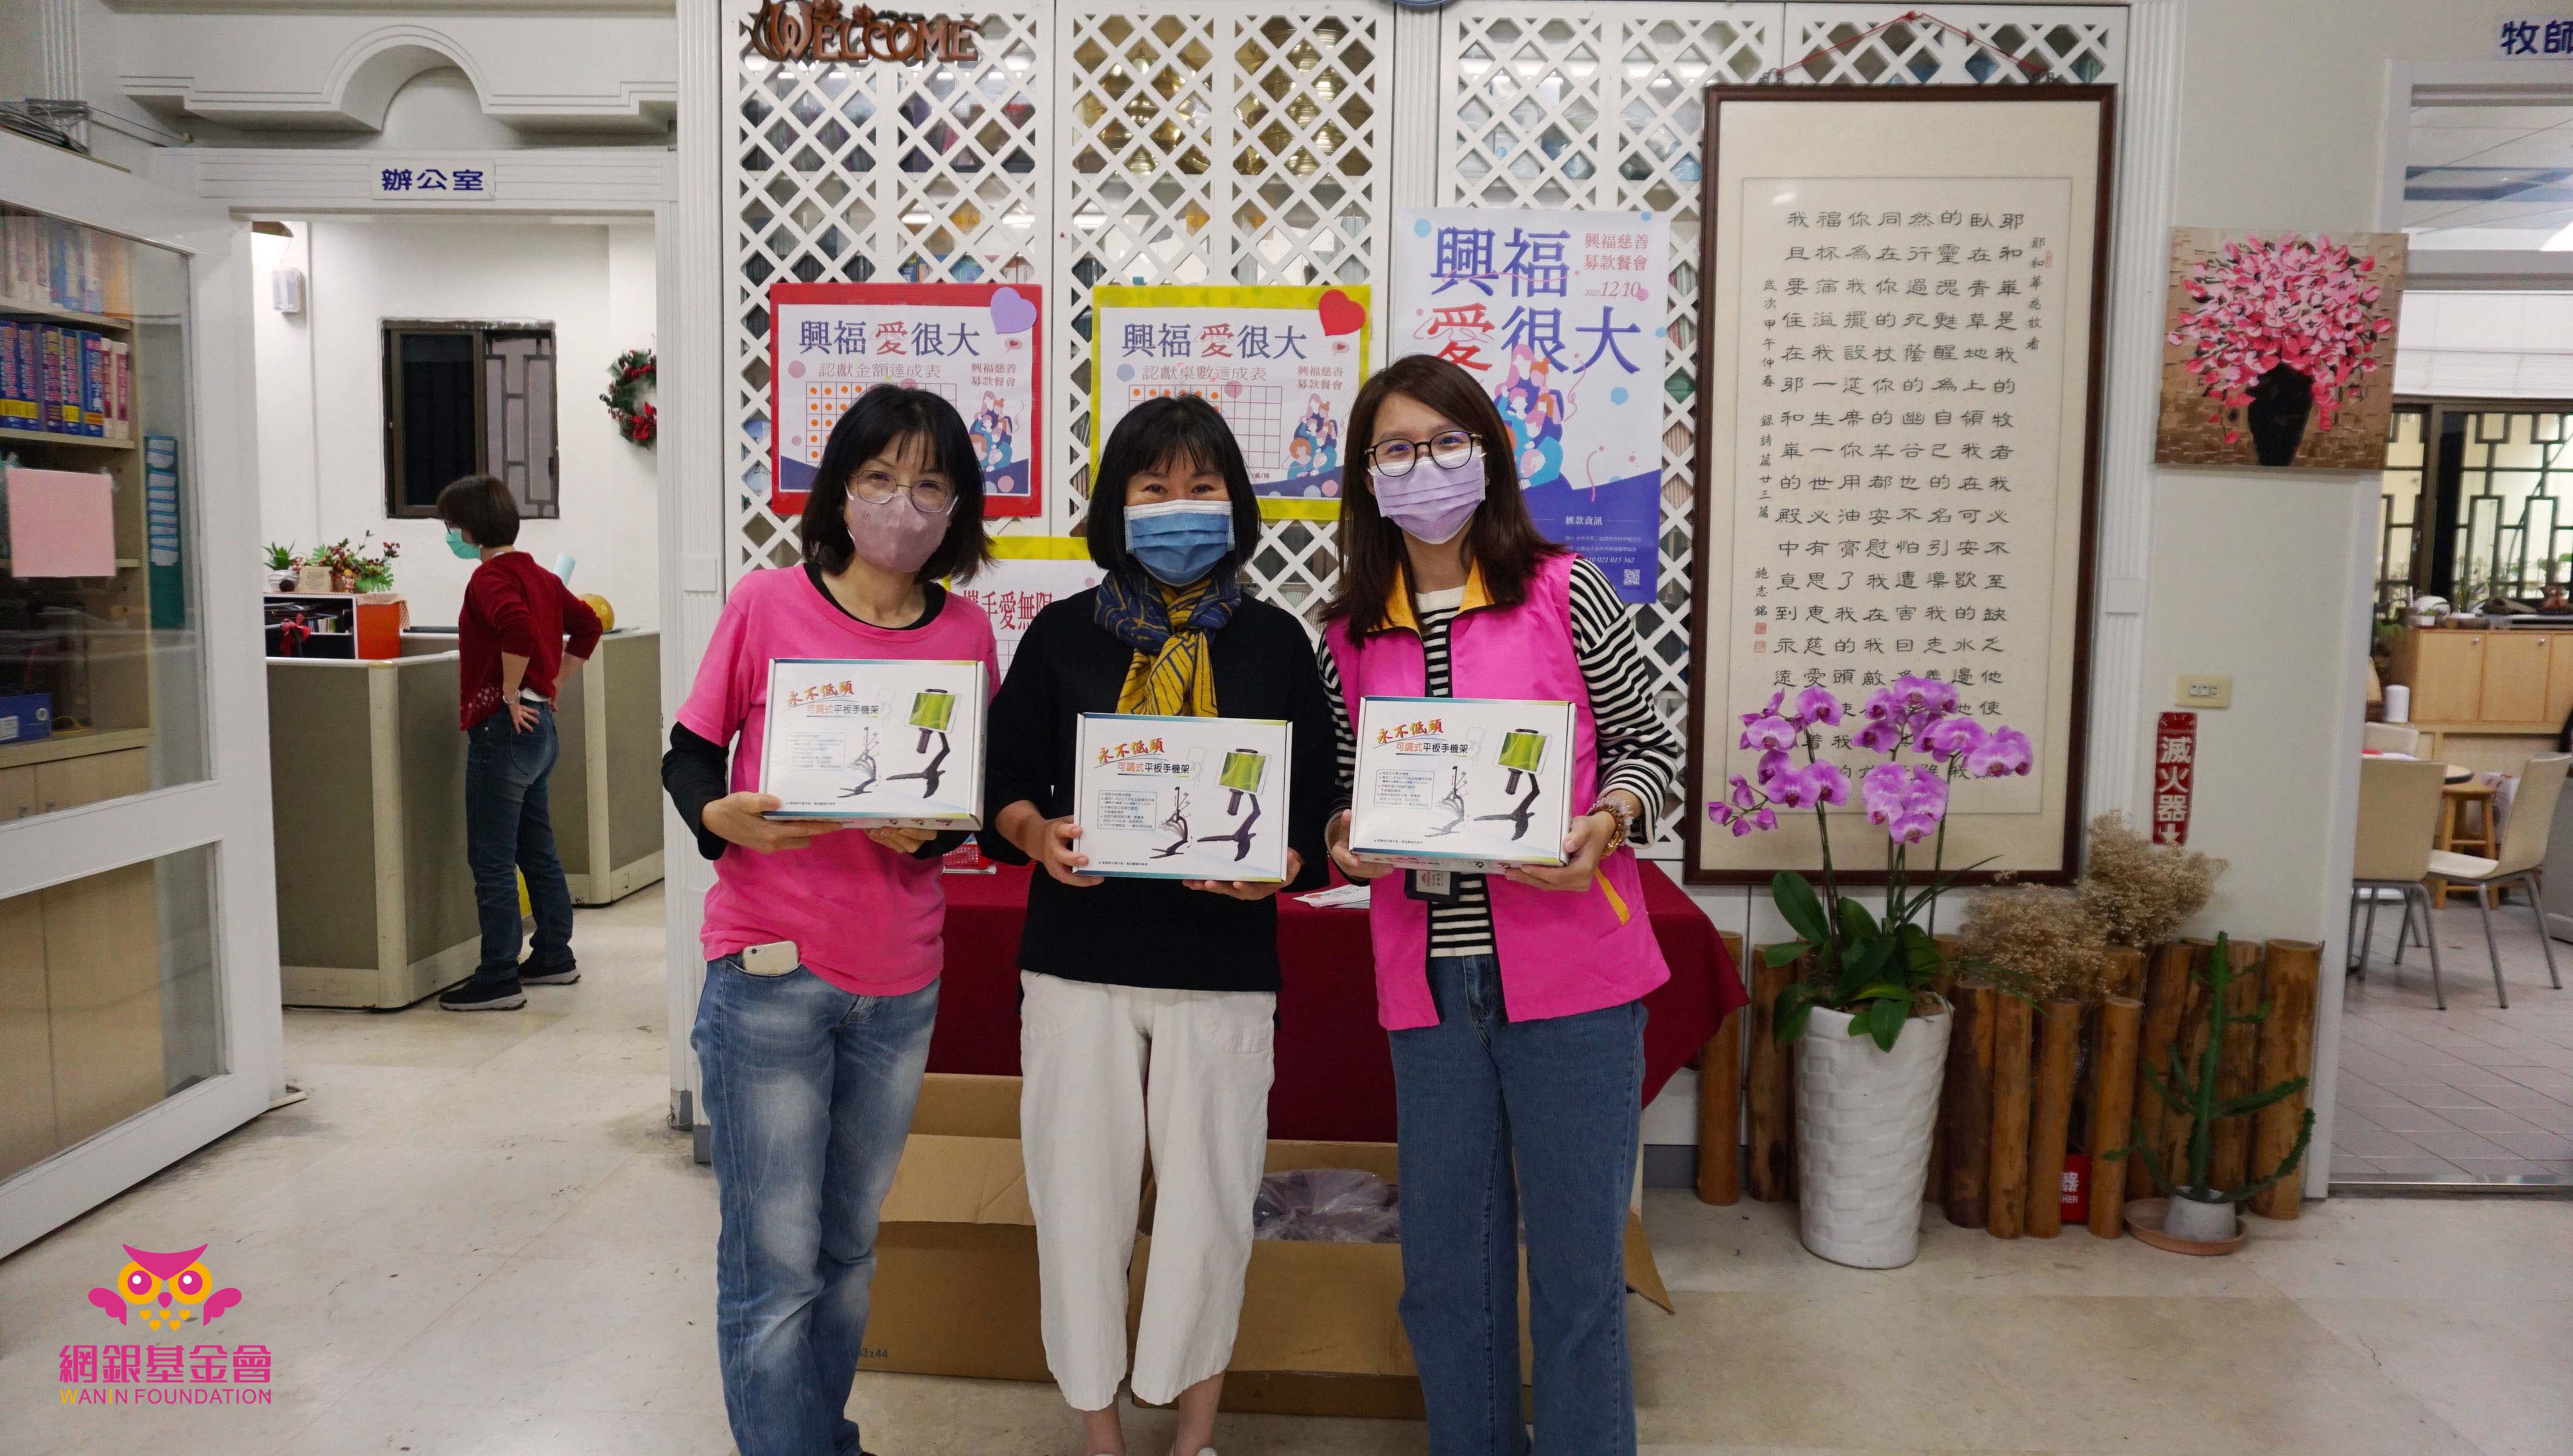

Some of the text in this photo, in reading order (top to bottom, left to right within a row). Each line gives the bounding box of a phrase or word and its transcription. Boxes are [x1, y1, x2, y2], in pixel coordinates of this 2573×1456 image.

[749, 0, 979, 61] WELCOME
[382, 169, 483, 190] 辦公室
[1584, 233, 1649, 249] 興福慈善
[1430, 226, 1571, 297] 興福
[1584, 254, 1648, 271] 募款餐會
[799, 320, 980, 356] 興福愛很大
[1121, 323, 1307, 359] 興福愛很大
[1427, 302, 1640, 374] 愛很大
[818, 362, 941, 379] 認獻金額達成表
[971, 363, 1016, 374] 興福慈善
[1141, 365, 1266, 381] 認獻桌數達成表
[1297, 365, 1344, 377] 興福慈善
[971, 376, 1015, 386] 募款餐會
[1297, 379, 1343, 390] 募款餐會
[1566, 516, 1603, 525] 匯款資訊
[1376, 719, 1444, 744] 永不低頭
[1097, 738, 1165, 763] 永不低頭
[1396, 743, 1468, 754] 可調式平板手機架
[1117, 762, 1189, 774] 可調式平板手機架
[2158, 736, 2193, 822] 滅火器
